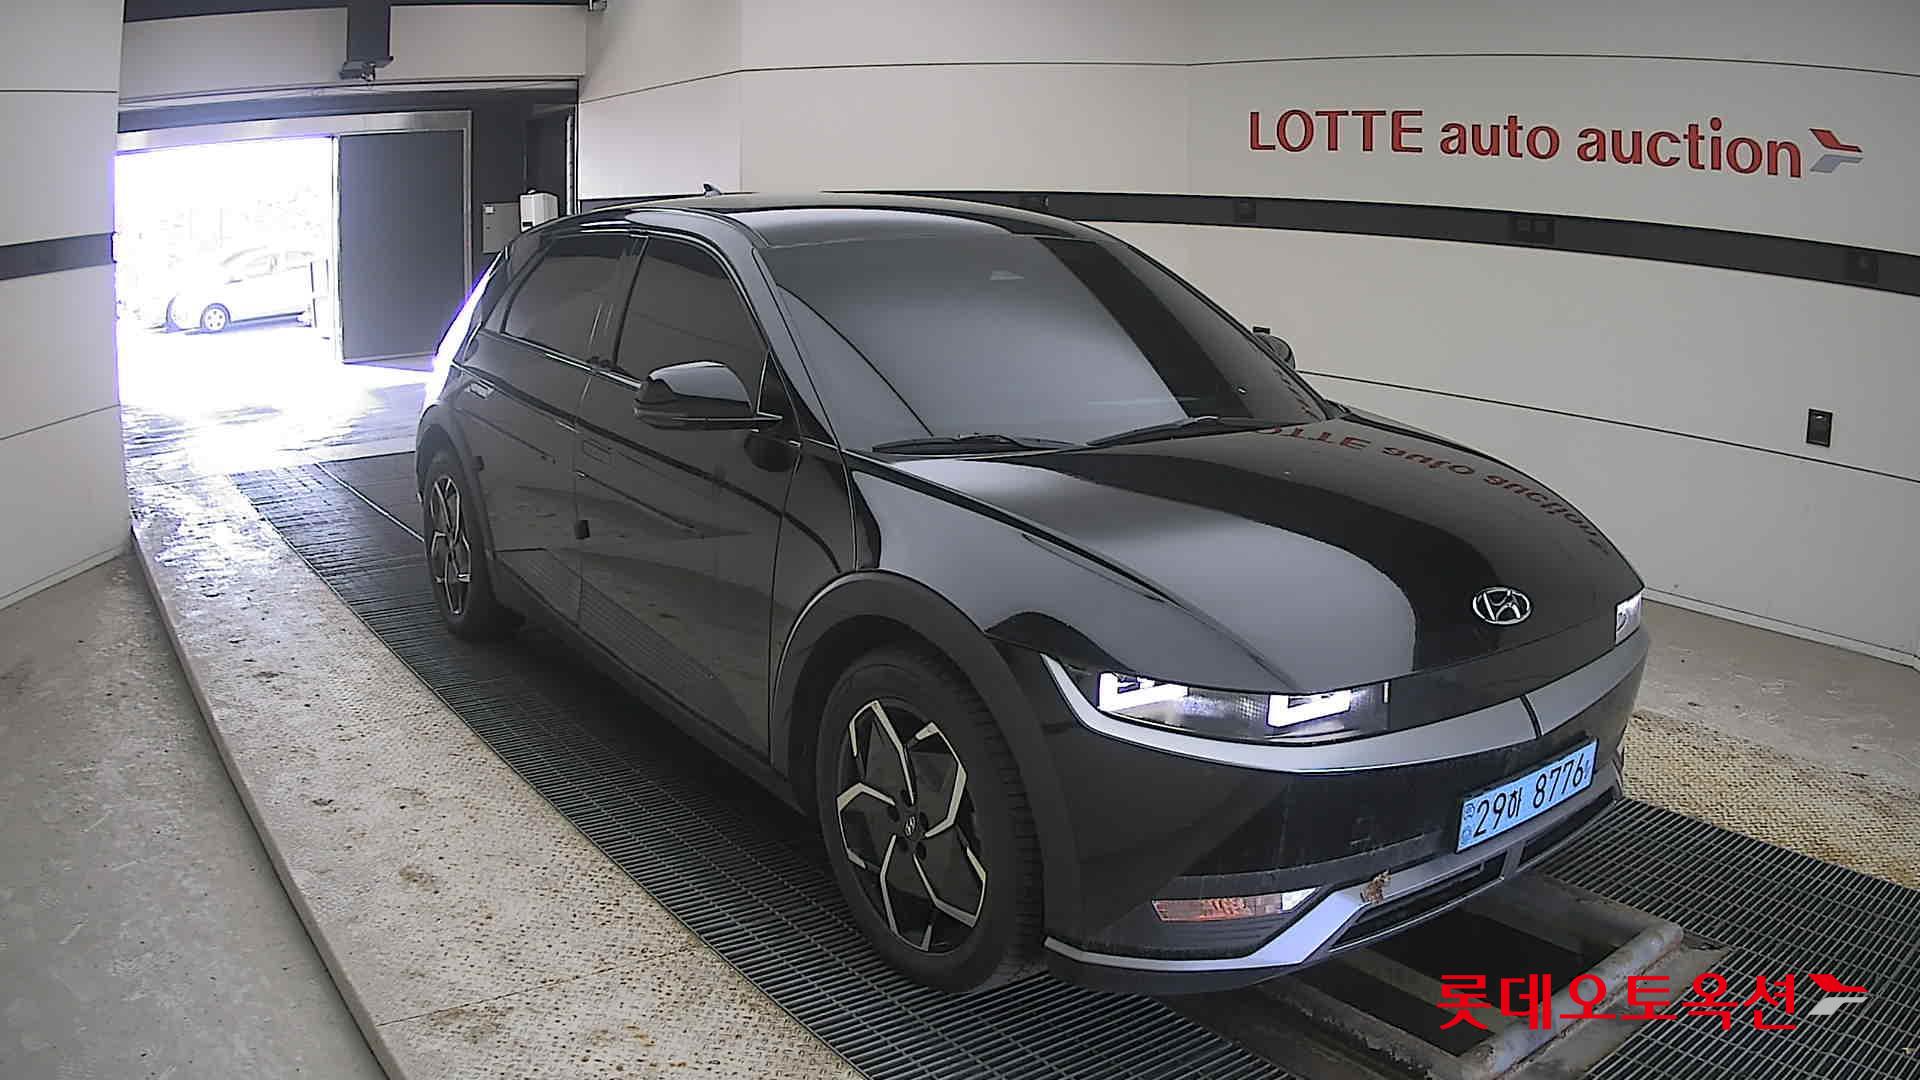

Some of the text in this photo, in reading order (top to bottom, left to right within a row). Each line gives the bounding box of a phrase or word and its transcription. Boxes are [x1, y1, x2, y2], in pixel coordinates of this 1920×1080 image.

[1249, 109, 1802, 179] LOTTE auto auction
[1473, 753, 1585, 838] 29하 8776
